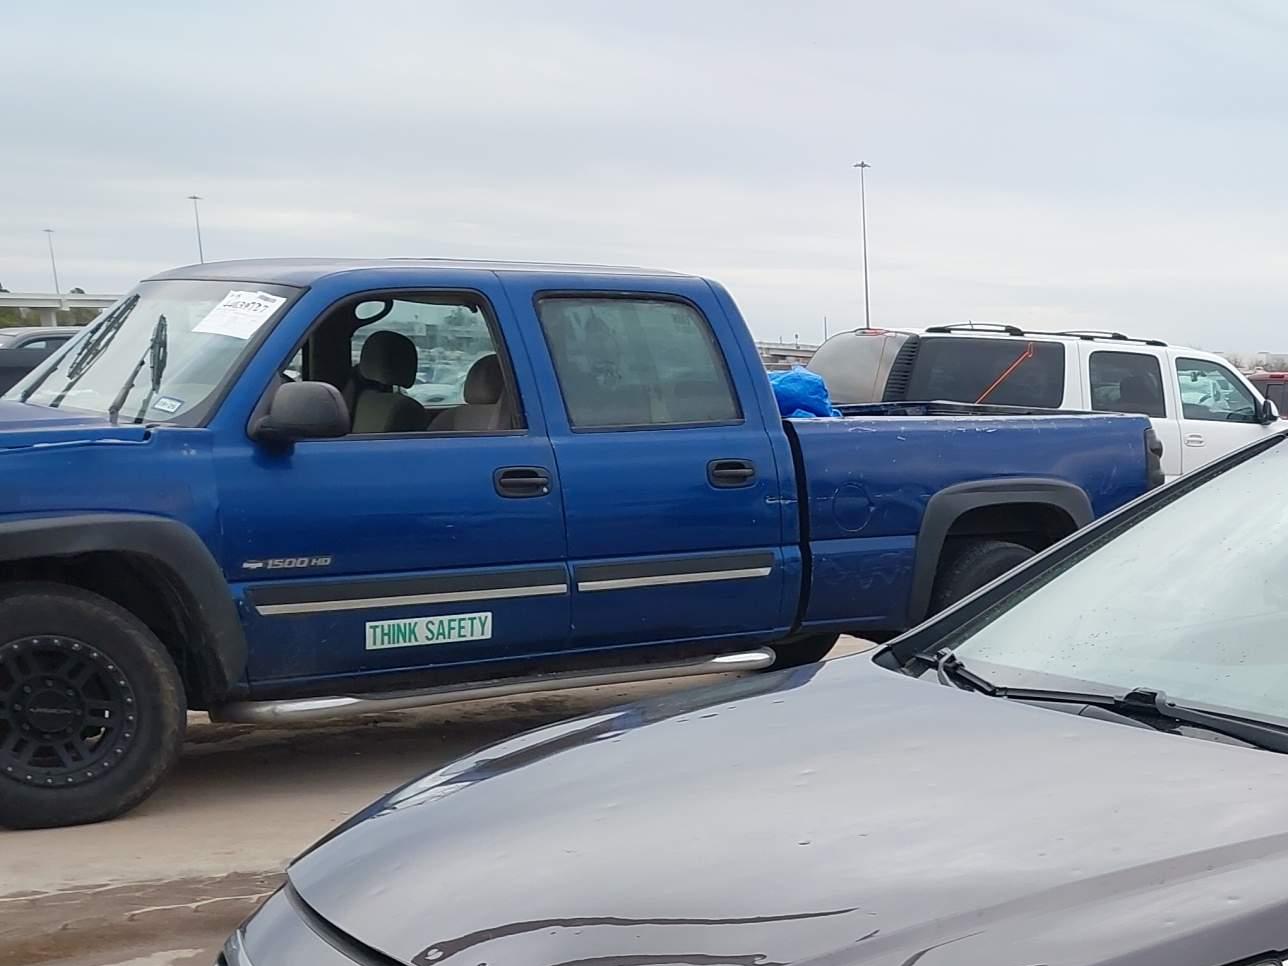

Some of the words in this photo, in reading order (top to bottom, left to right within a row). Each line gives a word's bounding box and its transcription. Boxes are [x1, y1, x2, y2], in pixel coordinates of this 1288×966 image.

[265, 557, 308, 570] 1500
[311, 557, 331, 567] HD
[369, 621, 418, 646] THINK
[425, 615, 489, 642] SAFETY
